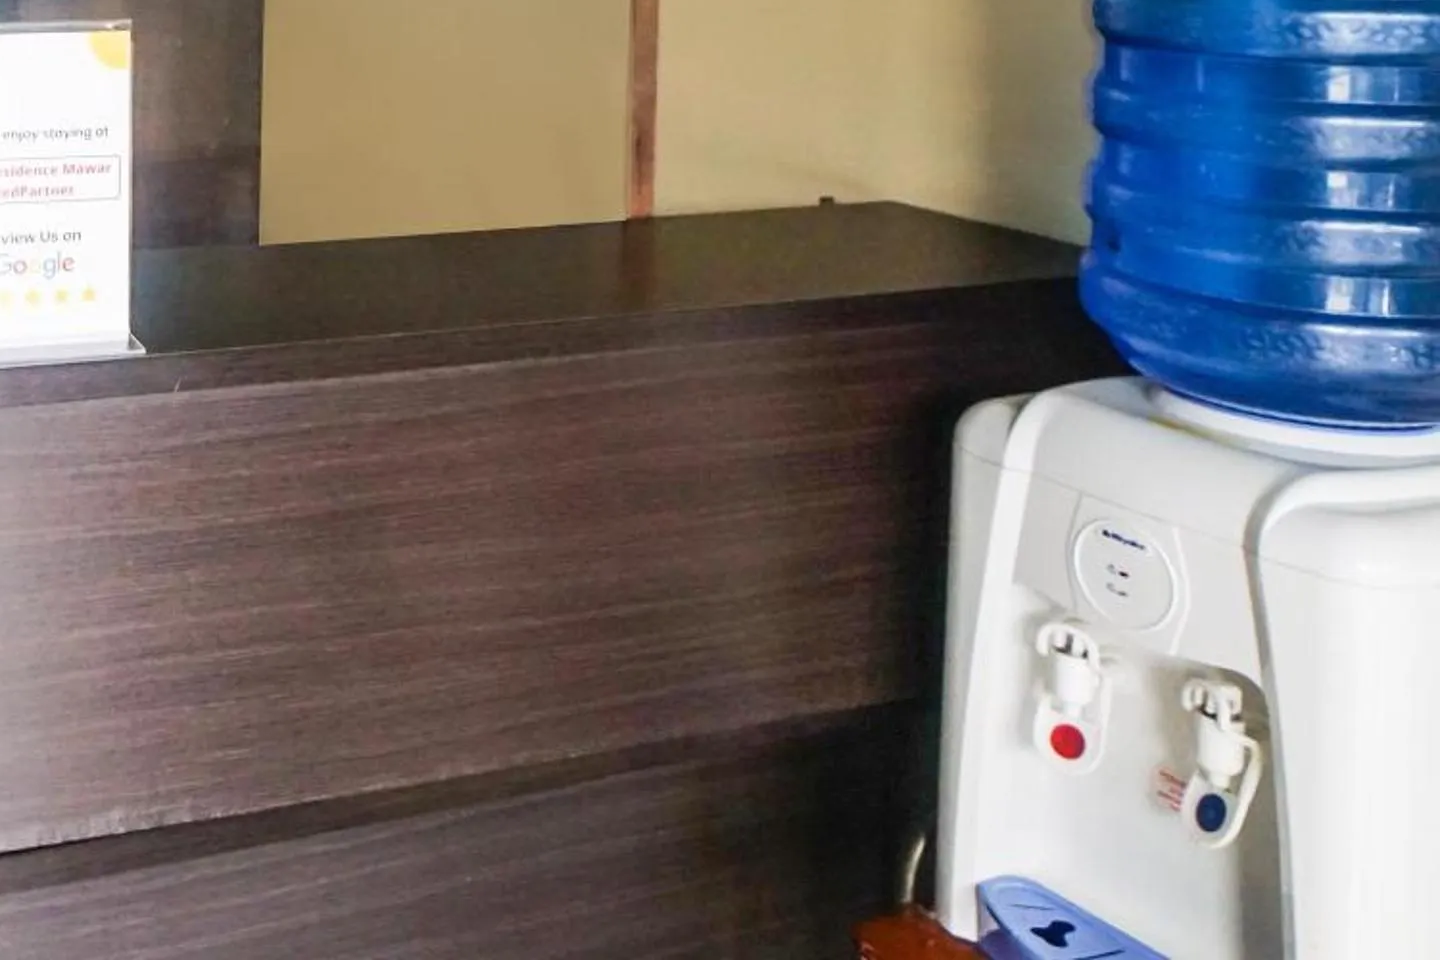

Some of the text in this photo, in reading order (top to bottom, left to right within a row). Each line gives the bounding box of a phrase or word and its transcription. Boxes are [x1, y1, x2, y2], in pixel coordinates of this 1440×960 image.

[1, 128, 38, 143] enjoy
[43, 126, 93, 142] staying
[95, 125, 109, 138] at
[62, 163, 112, 176] Mawar
[39, 230, 58, 244] Us
[62, 230, 82, 243] on
